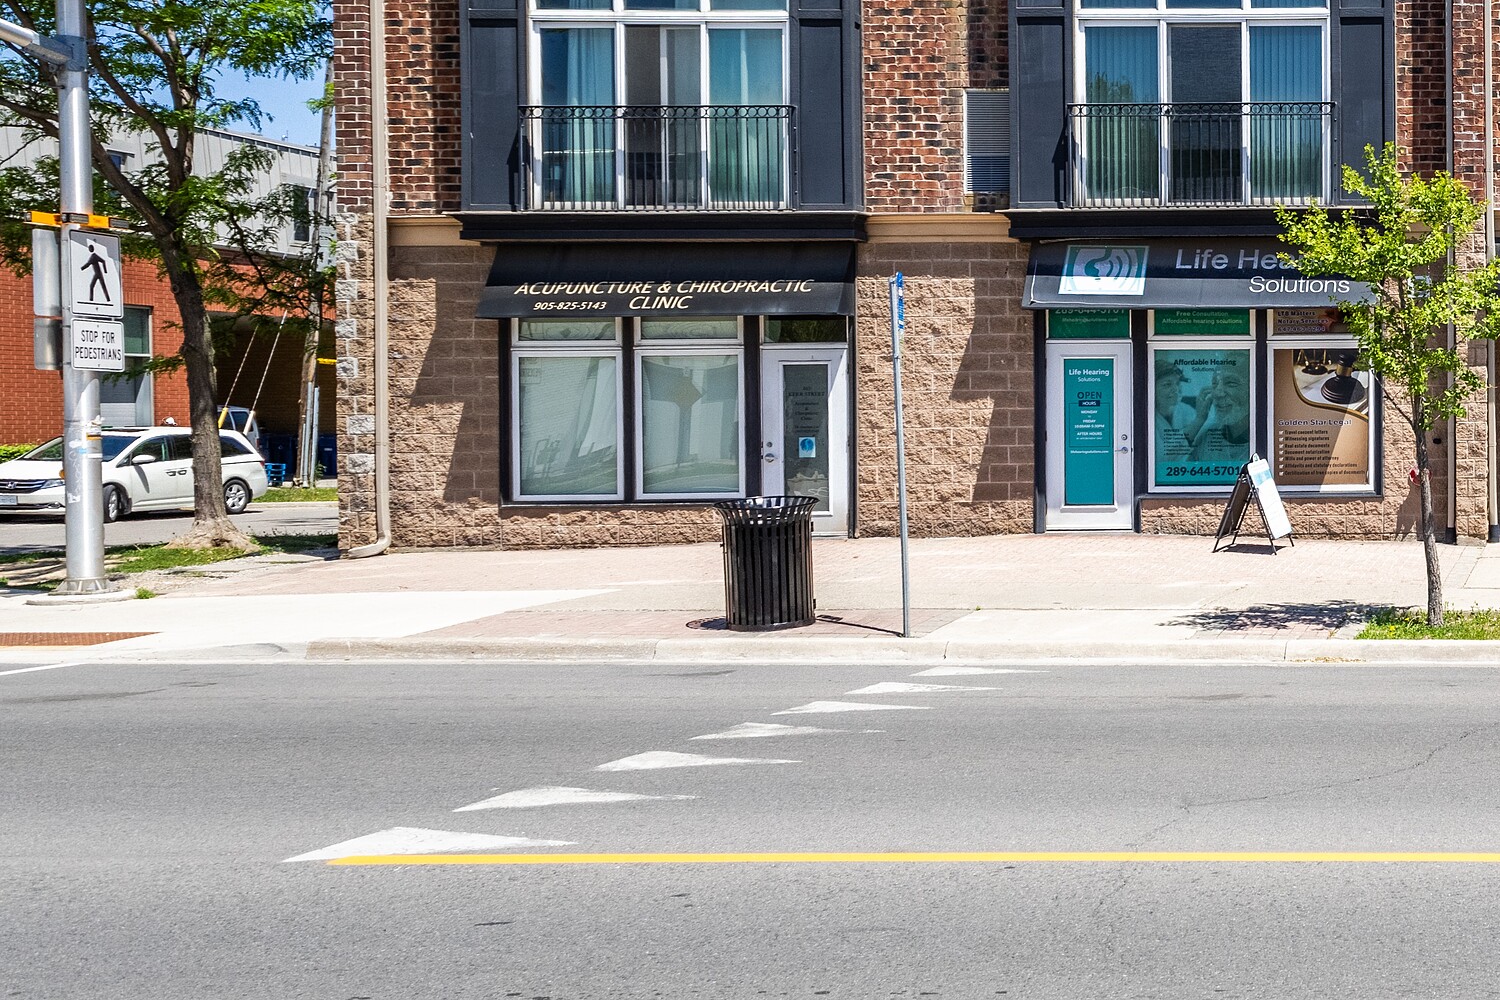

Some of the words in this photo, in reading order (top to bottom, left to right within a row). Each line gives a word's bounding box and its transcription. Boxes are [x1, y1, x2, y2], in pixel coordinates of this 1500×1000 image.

[1175, 249, 1229, 269] Life
[514, 281, 656, 295] ACUPUNCTURE
[657, 281, 672, 293] &
[677, 279, 815, 293] CHIROPRACTIC
[1249, 275, 1350, 293] Solutions
[533, 301, 608, 310] 905-825-5143
[628, 295, 693, 309] CLINIC
[81, 330, 98, 342] STOP
[102, 331, 115, 343] FOR
[75, 346, 121, 360] PEDESTRIANS
